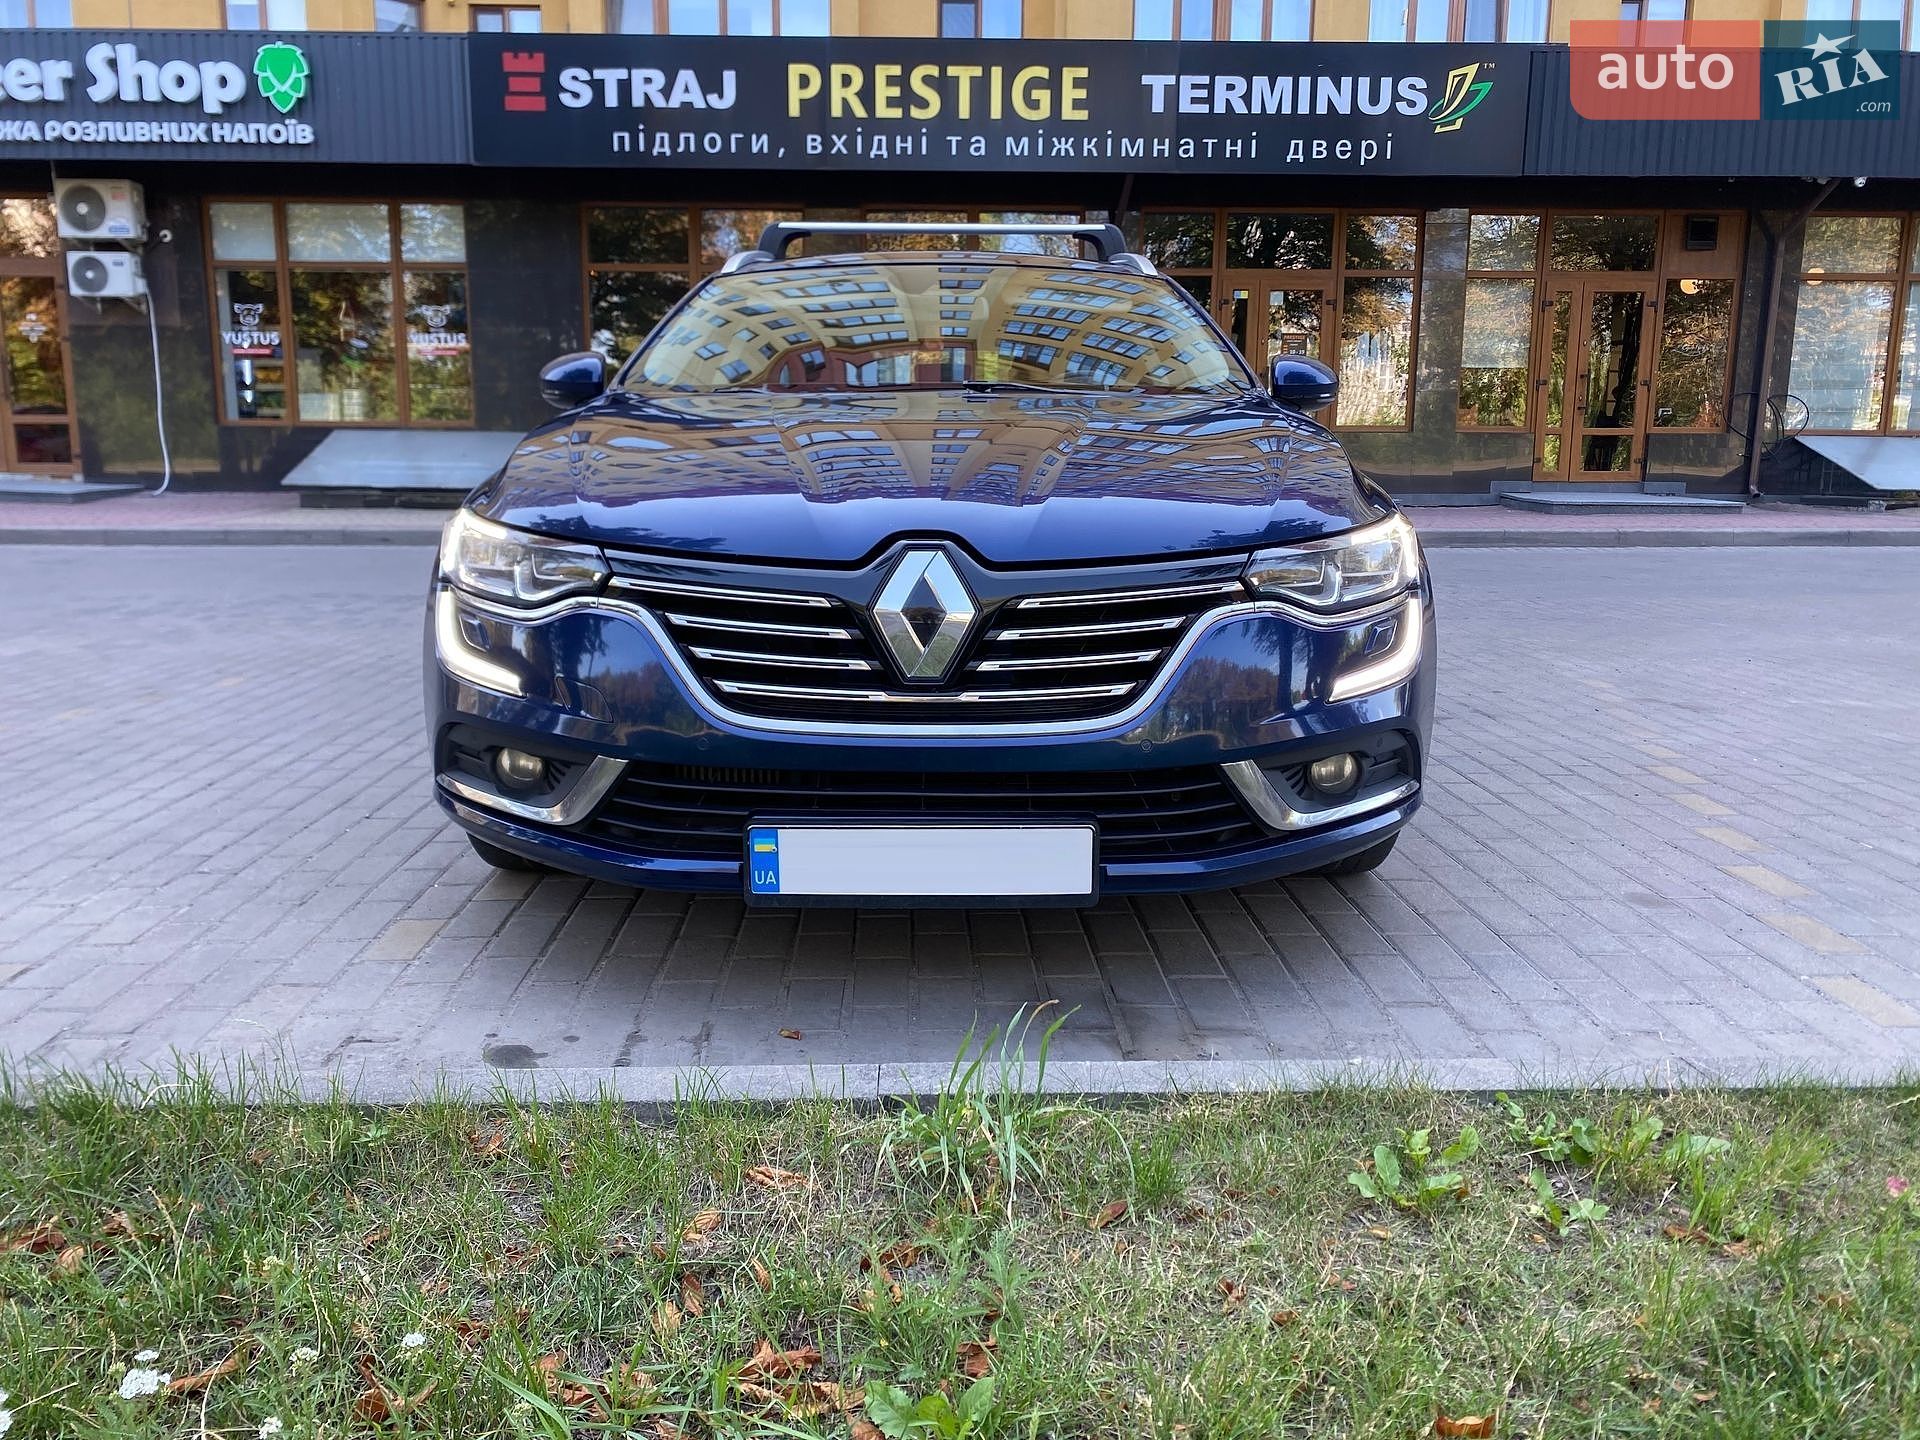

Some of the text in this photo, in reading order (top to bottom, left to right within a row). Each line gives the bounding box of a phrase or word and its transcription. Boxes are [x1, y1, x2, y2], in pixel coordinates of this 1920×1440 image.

[0, 42, 247, 115] er Shop
[558, 67, 737, 110] STRAJ
[787, 63, 1089, 121] PRESTIGE
[1141, 75, 1428, 116] TERMINUS
[44, 120, 209, 143] РОЗЛИВНИХ
[211, 118, 315, 144] НАПОЇВ
[612, 123, 1393, 166] підлоги, вхідні та міжкімнатні двері
[222, 331, 280, 345] YUSTUS
[754, 870, 777, 885] UA
